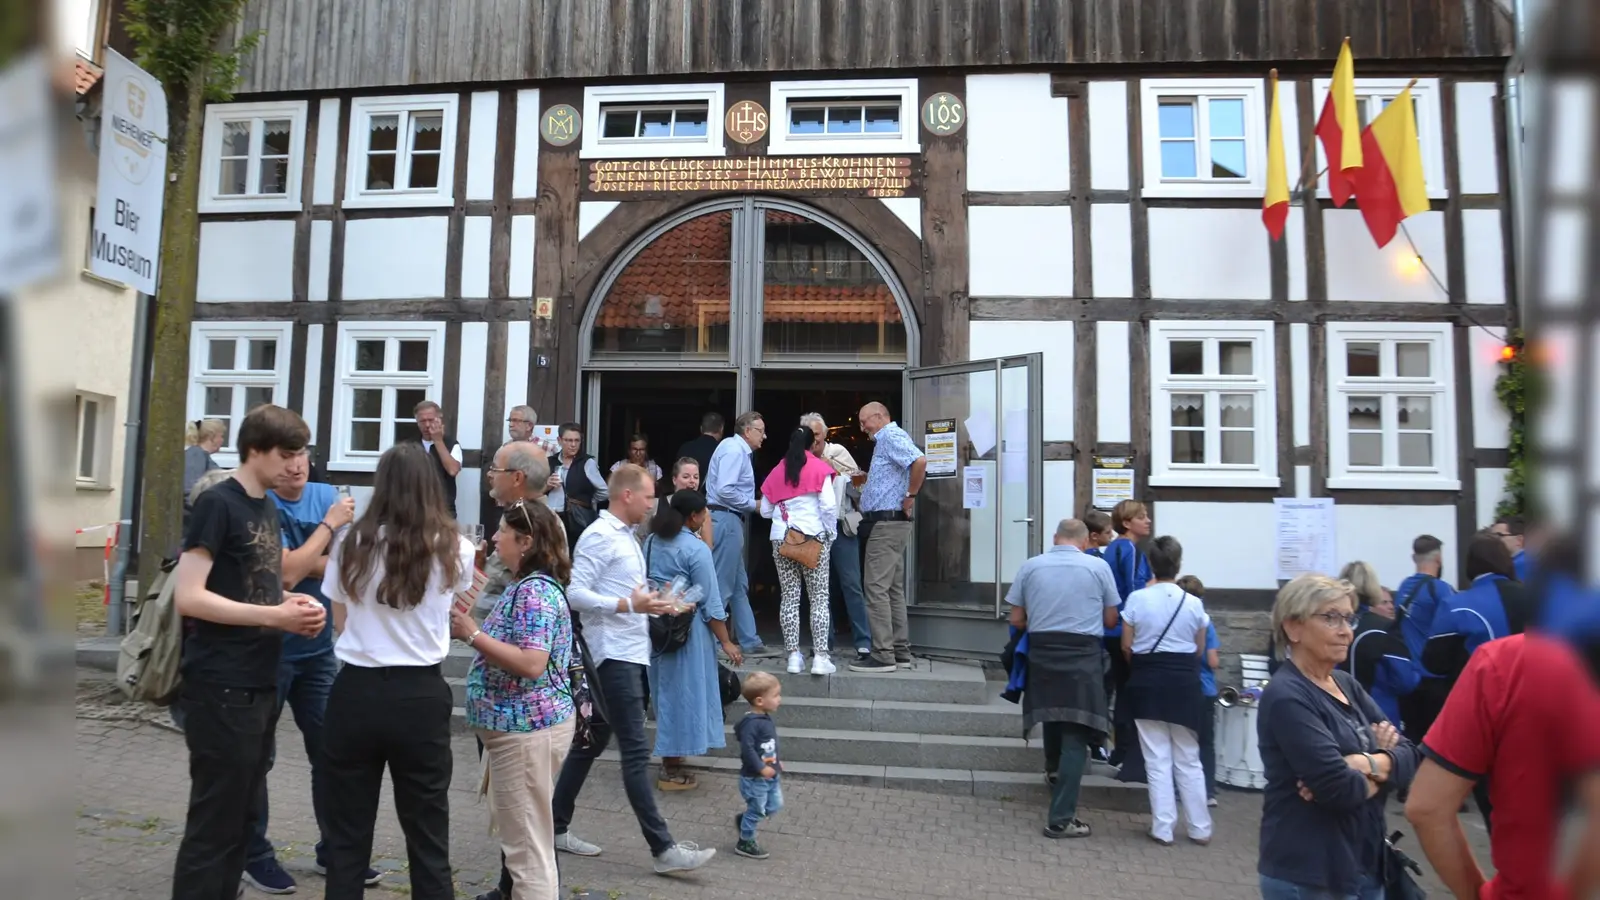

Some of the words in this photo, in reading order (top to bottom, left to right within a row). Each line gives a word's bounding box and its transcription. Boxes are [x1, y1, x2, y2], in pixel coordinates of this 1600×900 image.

[731, 104, 766, 131] IHS
[595, 160, 630, 172] GOTT
[633, 160, 656, 171] GIB
[660, 158, 705, 171] GLÜCK
[712, 159, 743, 170] UND
[596, 171, 647, 181] DENEN
[654, 170, 677, 181] DIE
[680, 170, 731, 180] DIESES
[747, 168, 789, 179] HAUS
[800, 167, 896, 178] BEWOHNEN
[594, 181, 644, 192] JOSEPH
[654, 180, 701, 191] RIECKS
[709, 180, 739, 190] UND
[114, 198, 140, 234] Bier
[92, 228, 152, 280] Museum
[540, 356, 546, 366] 5
